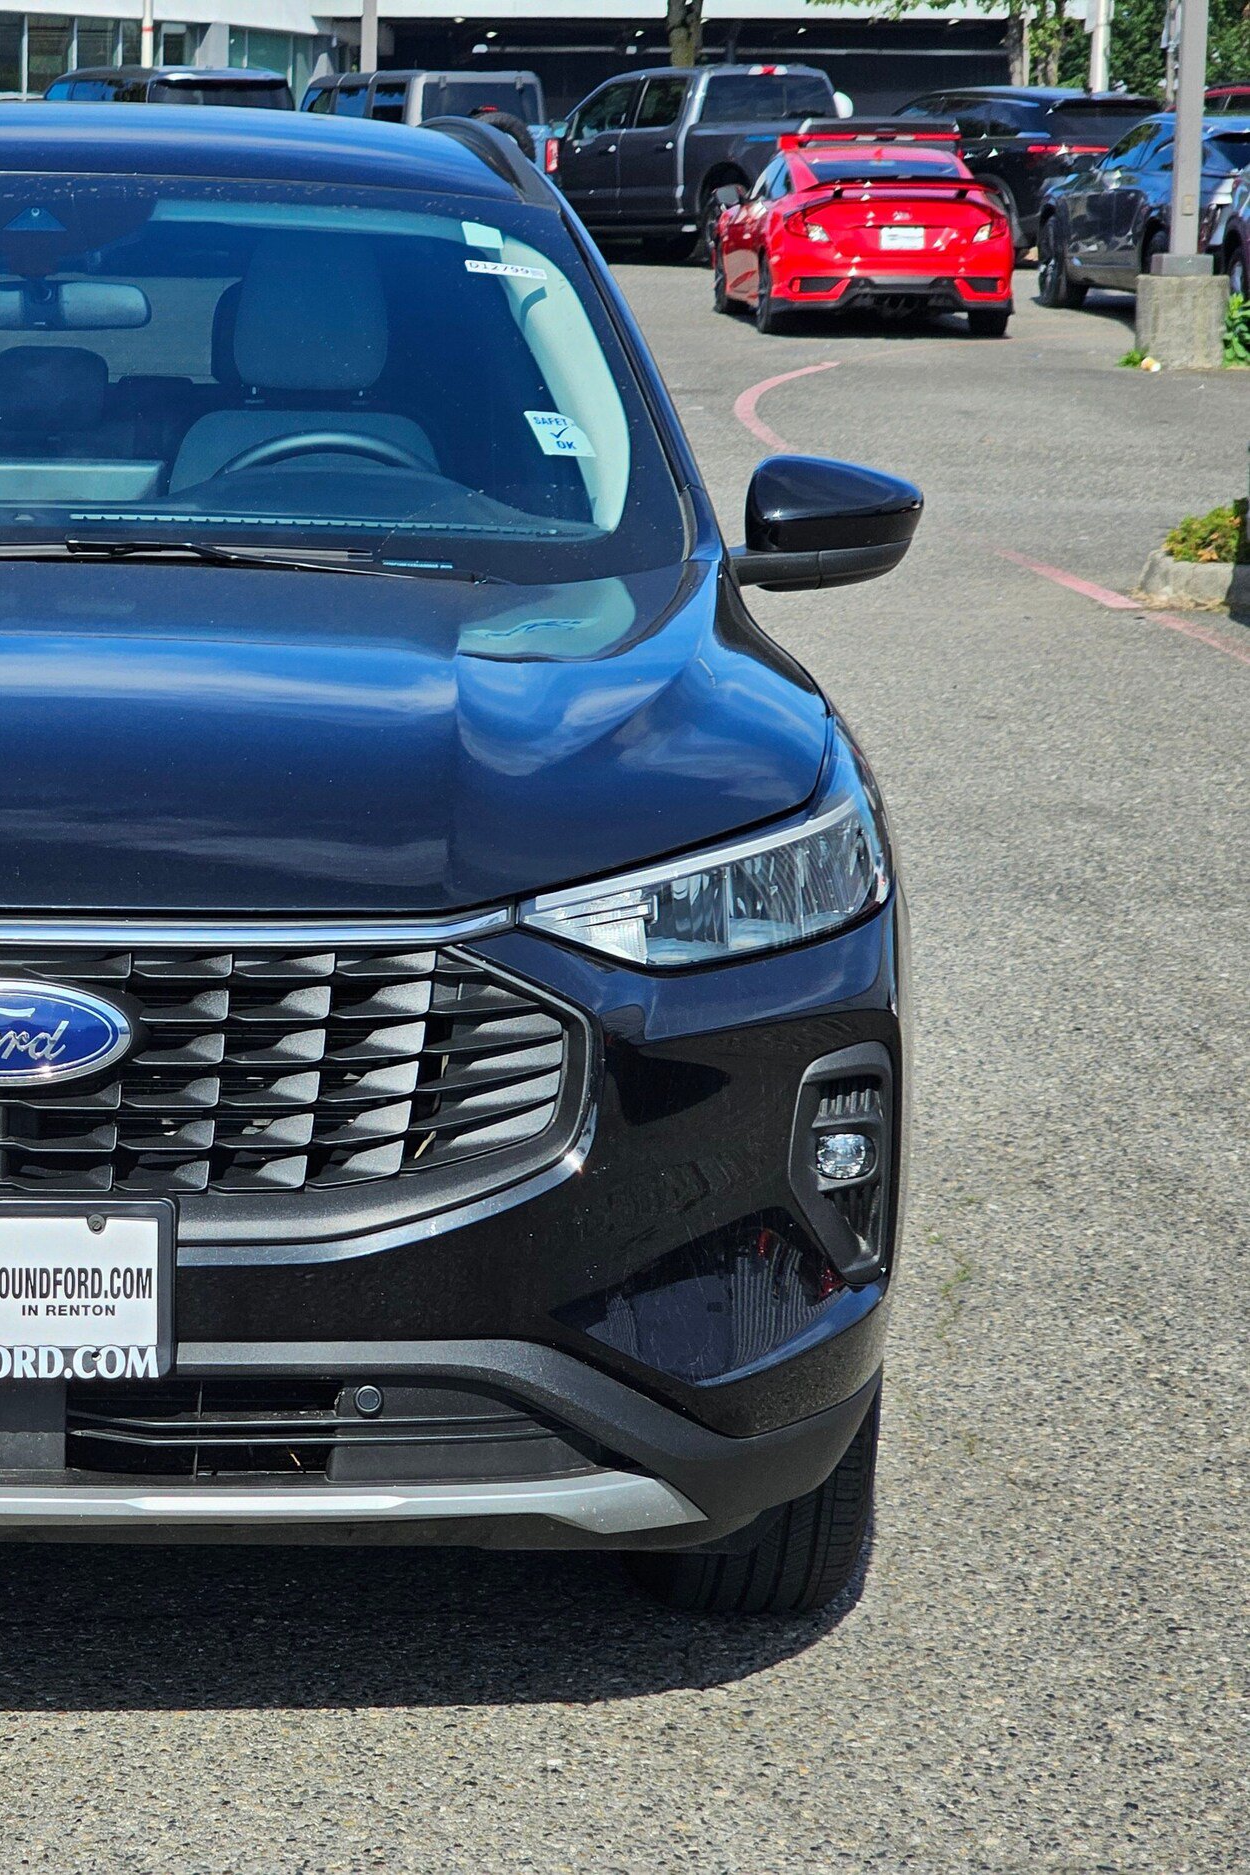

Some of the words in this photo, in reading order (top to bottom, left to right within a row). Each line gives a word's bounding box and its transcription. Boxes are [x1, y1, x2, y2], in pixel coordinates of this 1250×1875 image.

[533, 416, 574, 426] SAFET
[556, 441, 577, 450] OK
[21, 1304, 39, 1317] IN
[46, 1304, 116, 1317] RENTON
